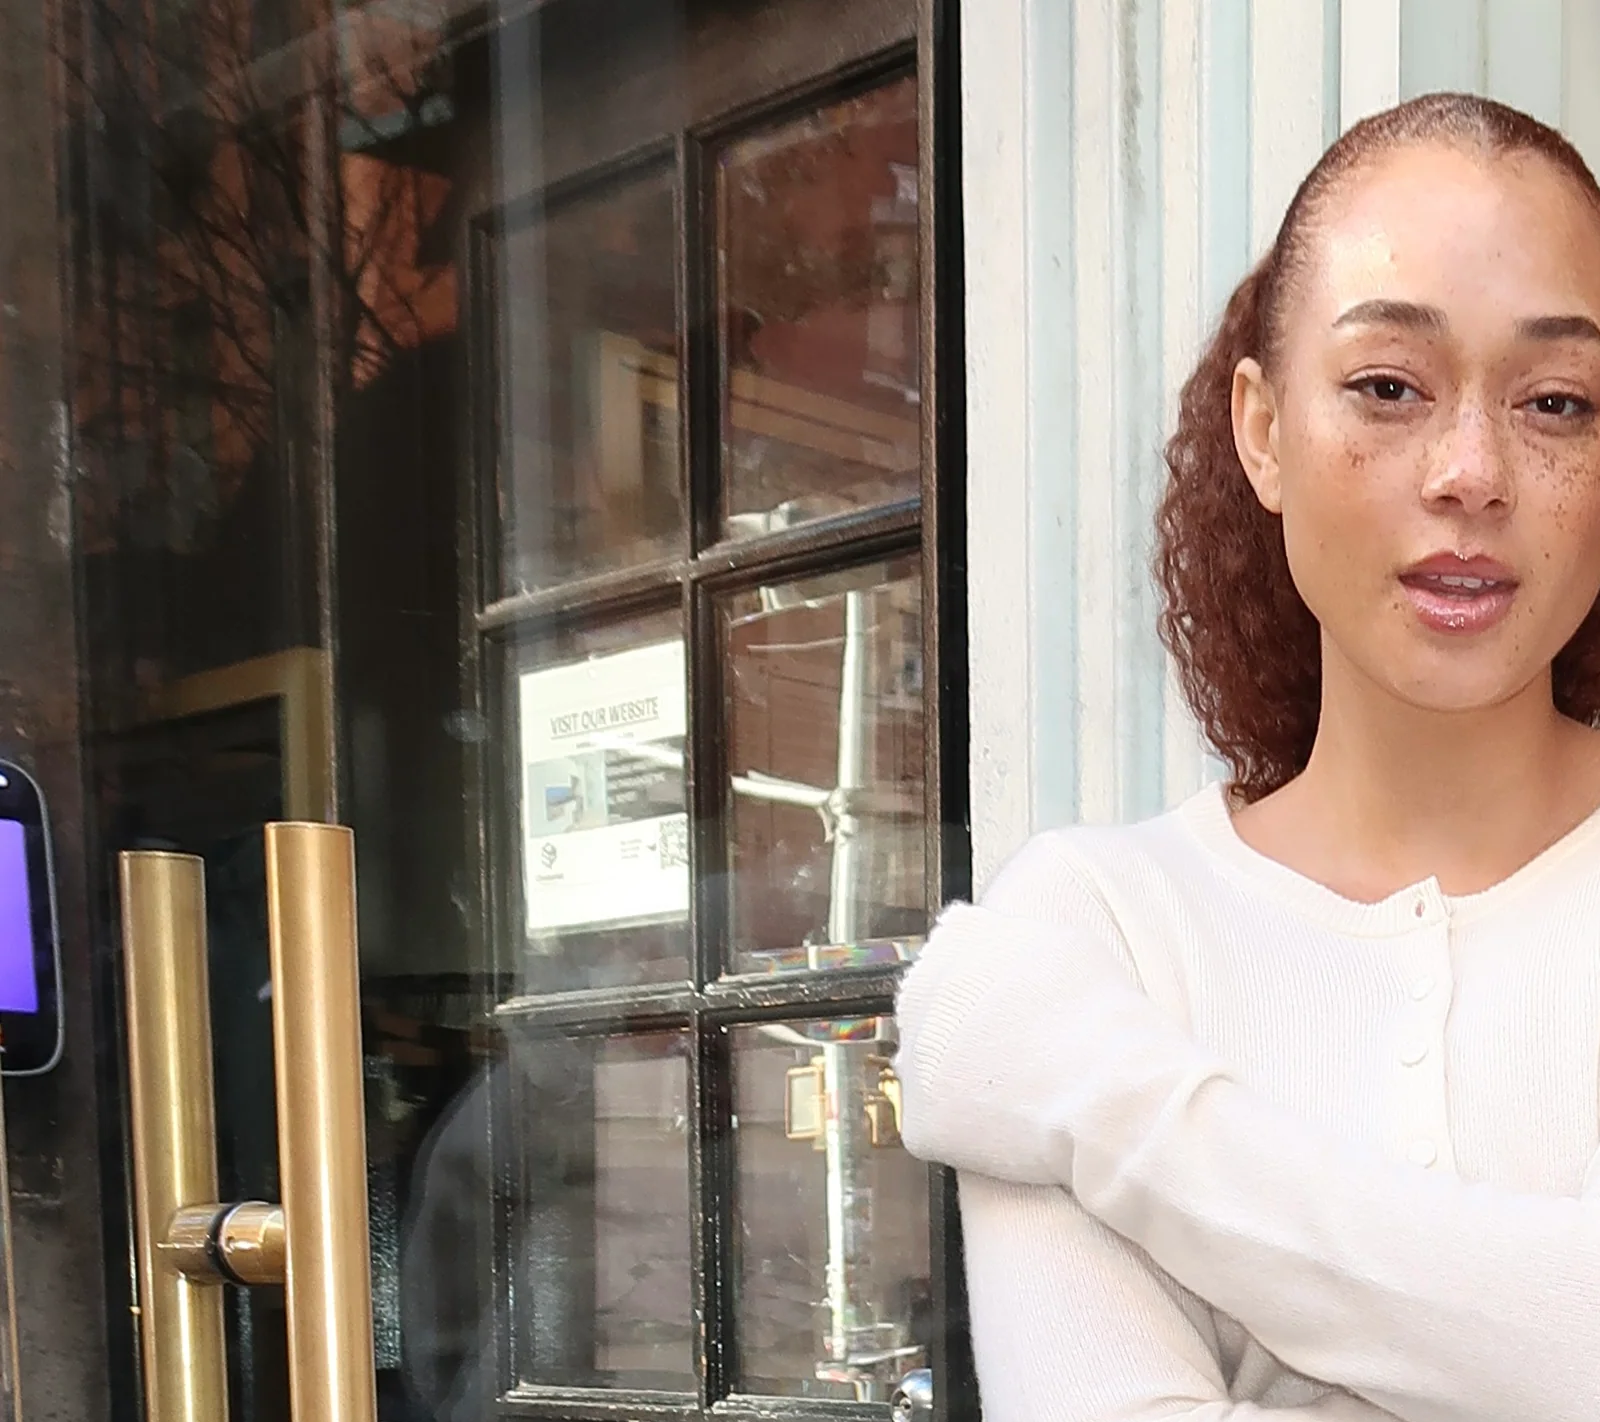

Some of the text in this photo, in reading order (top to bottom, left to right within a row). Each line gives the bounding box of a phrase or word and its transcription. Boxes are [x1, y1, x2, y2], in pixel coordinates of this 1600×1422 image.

[550, 696, 658, 735] VISIT OUR WEBSITE
